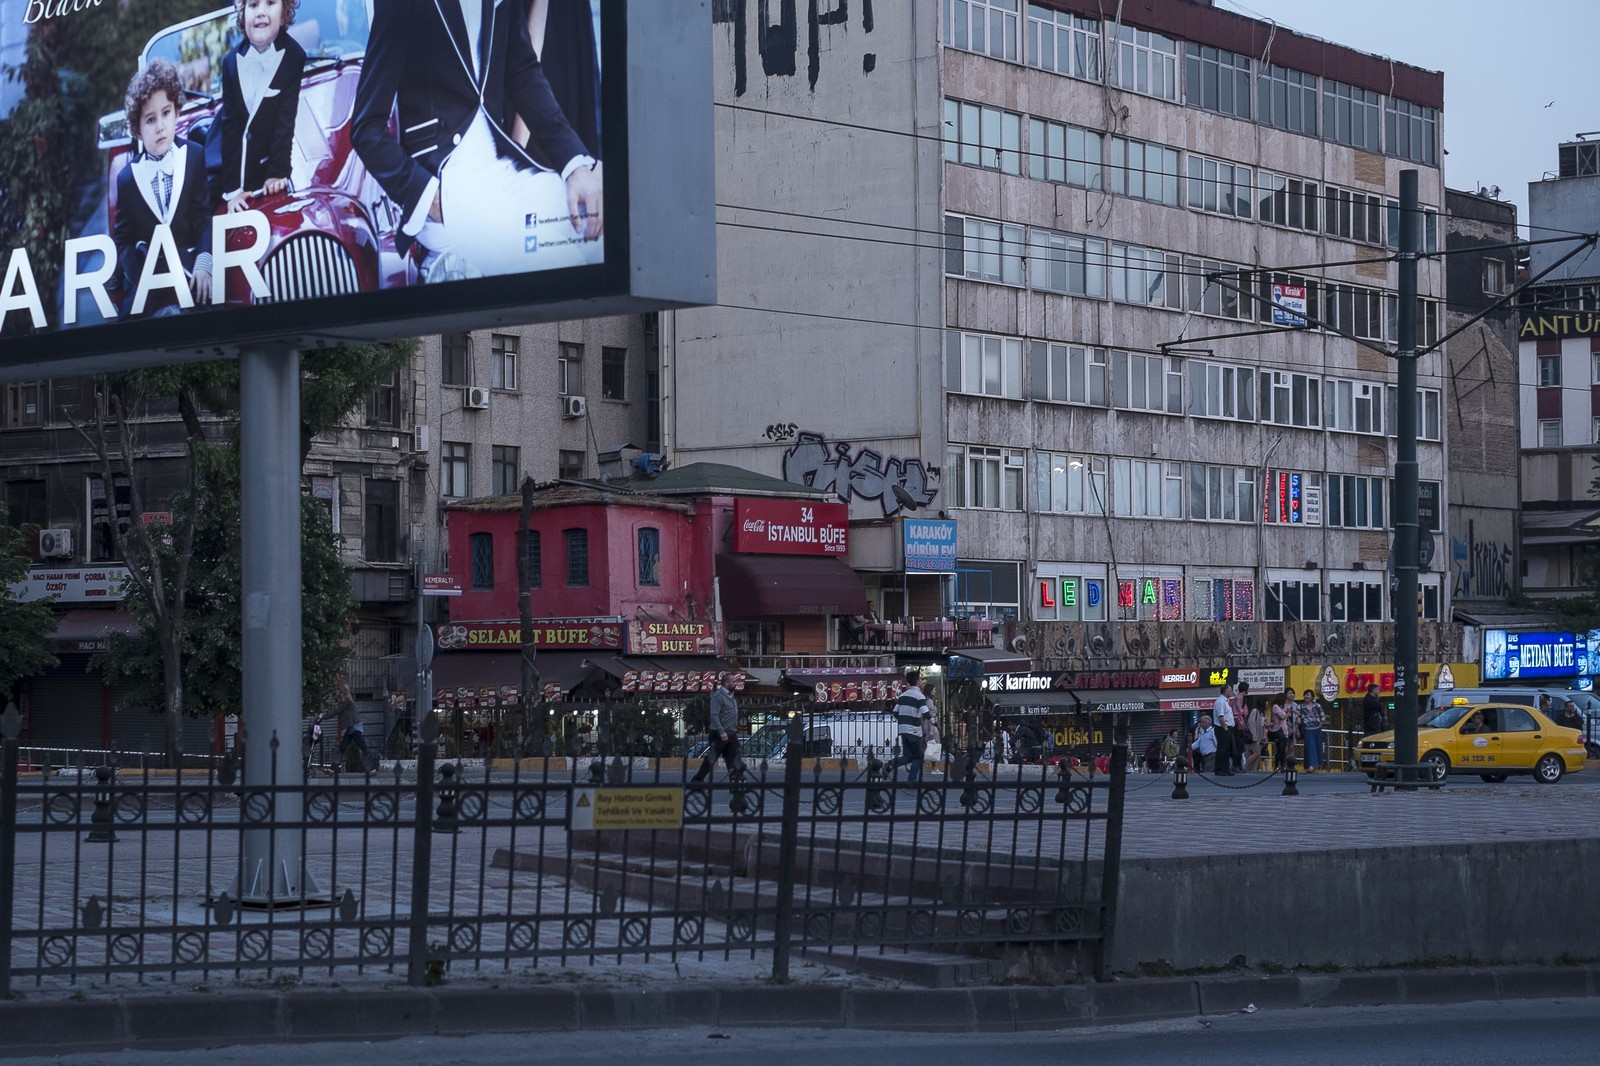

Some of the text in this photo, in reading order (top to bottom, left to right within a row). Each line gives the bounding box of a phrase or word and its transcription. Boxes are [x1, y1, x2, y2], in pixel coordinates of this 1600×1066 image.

[801, 507, 814, 523] 34
[768, 520, 846, 544] İSTANBUL BÜFE
[909, 523, 953, 540] KARAKÖY
[824, 544, 846, 553] Since 1999
[906, 542, 956, 558] DÜRÜM EVİ
[84, 573, 107, 583] ÇORBA
[424, 576, 454, 584] KEMERALTI
[1040, 580, 1101, 607] LED
[468, 626, 589, 645] SELAMT BÜFE
[648, 623, 705, 636] SELAMET
[78, 642, 96, 650] HACI
[661, 637, 693, 652] BÜFE
[1519, 637, 1574, 668] MEYDAN BÜFE
[1006, 674, 1052, 690] karrimor
[1161, 674, 1191, 683] MERRELL
[1122, 702, 1145, 710] OUTDOOR
[1171, 701, 1200, 709] MERRELL
[597, 795, 612, 804] Ray
[645, 794, 673, 802] Girmek
